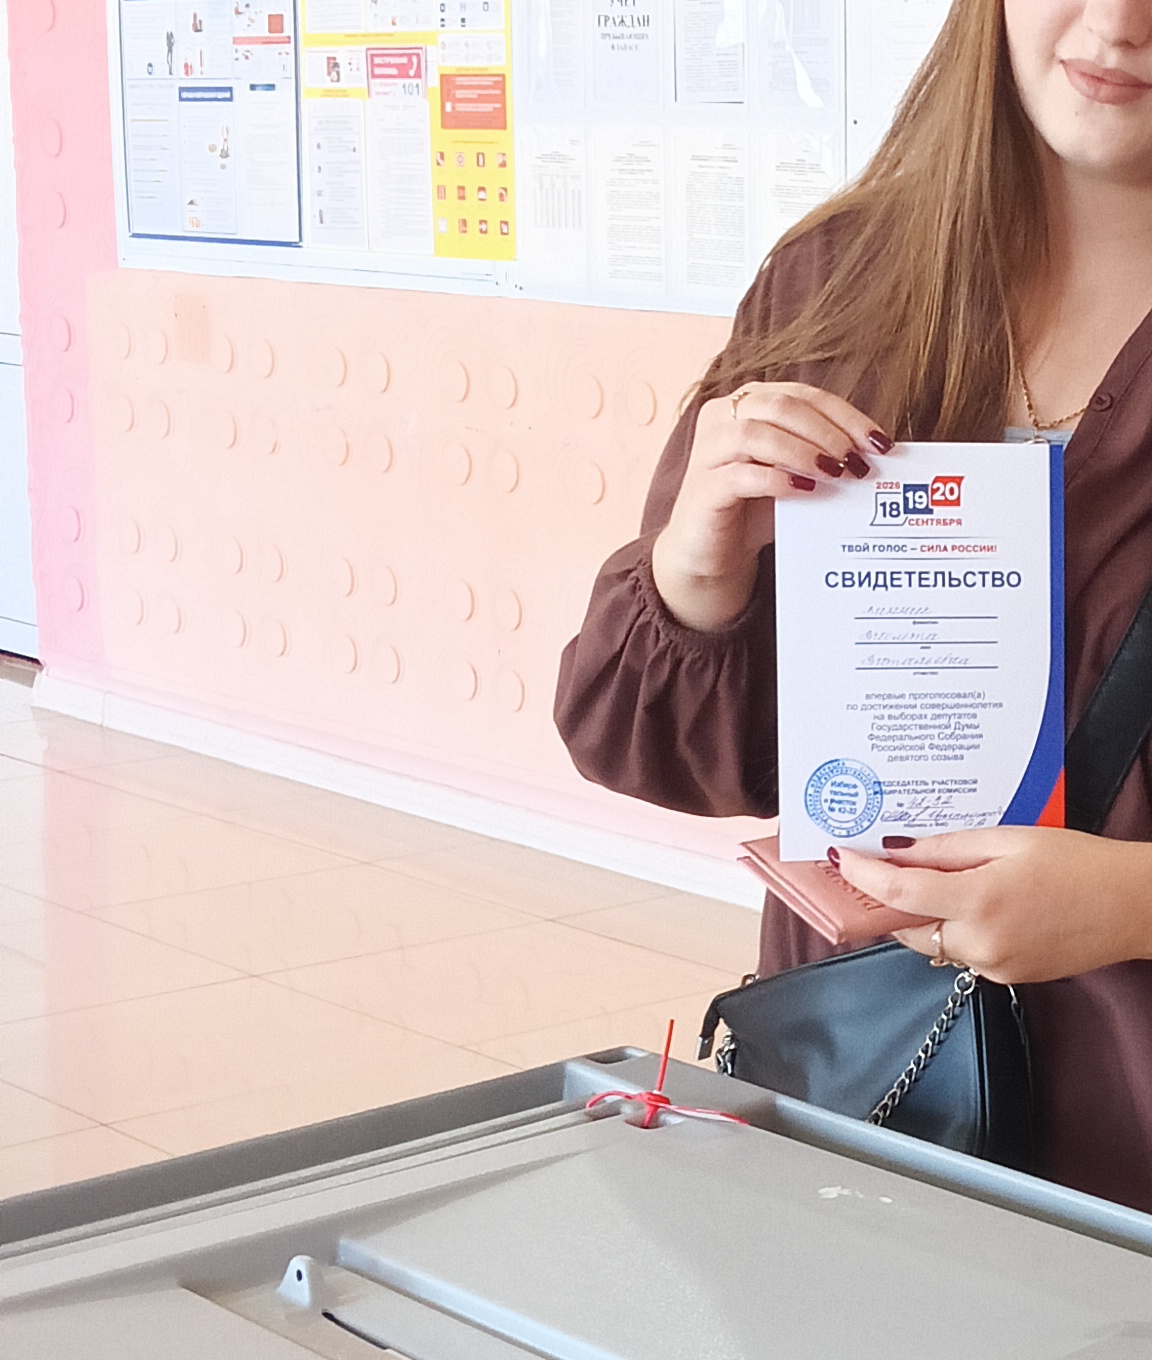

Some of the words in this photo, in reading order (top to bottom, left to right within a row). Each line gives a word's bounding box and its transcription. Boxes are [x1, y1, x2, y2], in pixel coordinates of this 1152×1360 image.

[597, 14, 650, 28] ГРАЖДАН
[401, 82, 420, 96] 101
[876, 482, 901, 490] 2026
[879, 501, 902, 519] 18
[904, 490, 928, 510] 19
[931, 482, 960, 501] 20
[907, 518, 962, 527] СЕНТЯБРЯ
[841, 543, 870, 553] ТВОЙ
[872, 544, 908, 553] ГОЛОС
[919, 544, 949, 553] СИЛА
[951, 544, 998, 553] РОССИИ!
[824, 570, 1022, 591] СВИДЕТЕЛЬСТВО
[865, 692, 906, 701] впервые
[908, 690, 986, 701] проголосовал(а)
[860, 702, 918, 712] достижении
[919, 701, 1003, 711] совершеннолетия
[887, 712, 928, 721] выборах
[930, 711, 978, 721] депутатов
[871, 721, 952, 732] Государственной
[954, 720, 980, 732] Думы
[867, 732, 935, 742] Федерального
[937, 730, 984, 742] Собрания
[871, 742, 926, 752] Российской
[928, 742, 981, 752] Федерации
[887, 754, 929, 762] девятого
[931, 752, 965, 761] созыва
